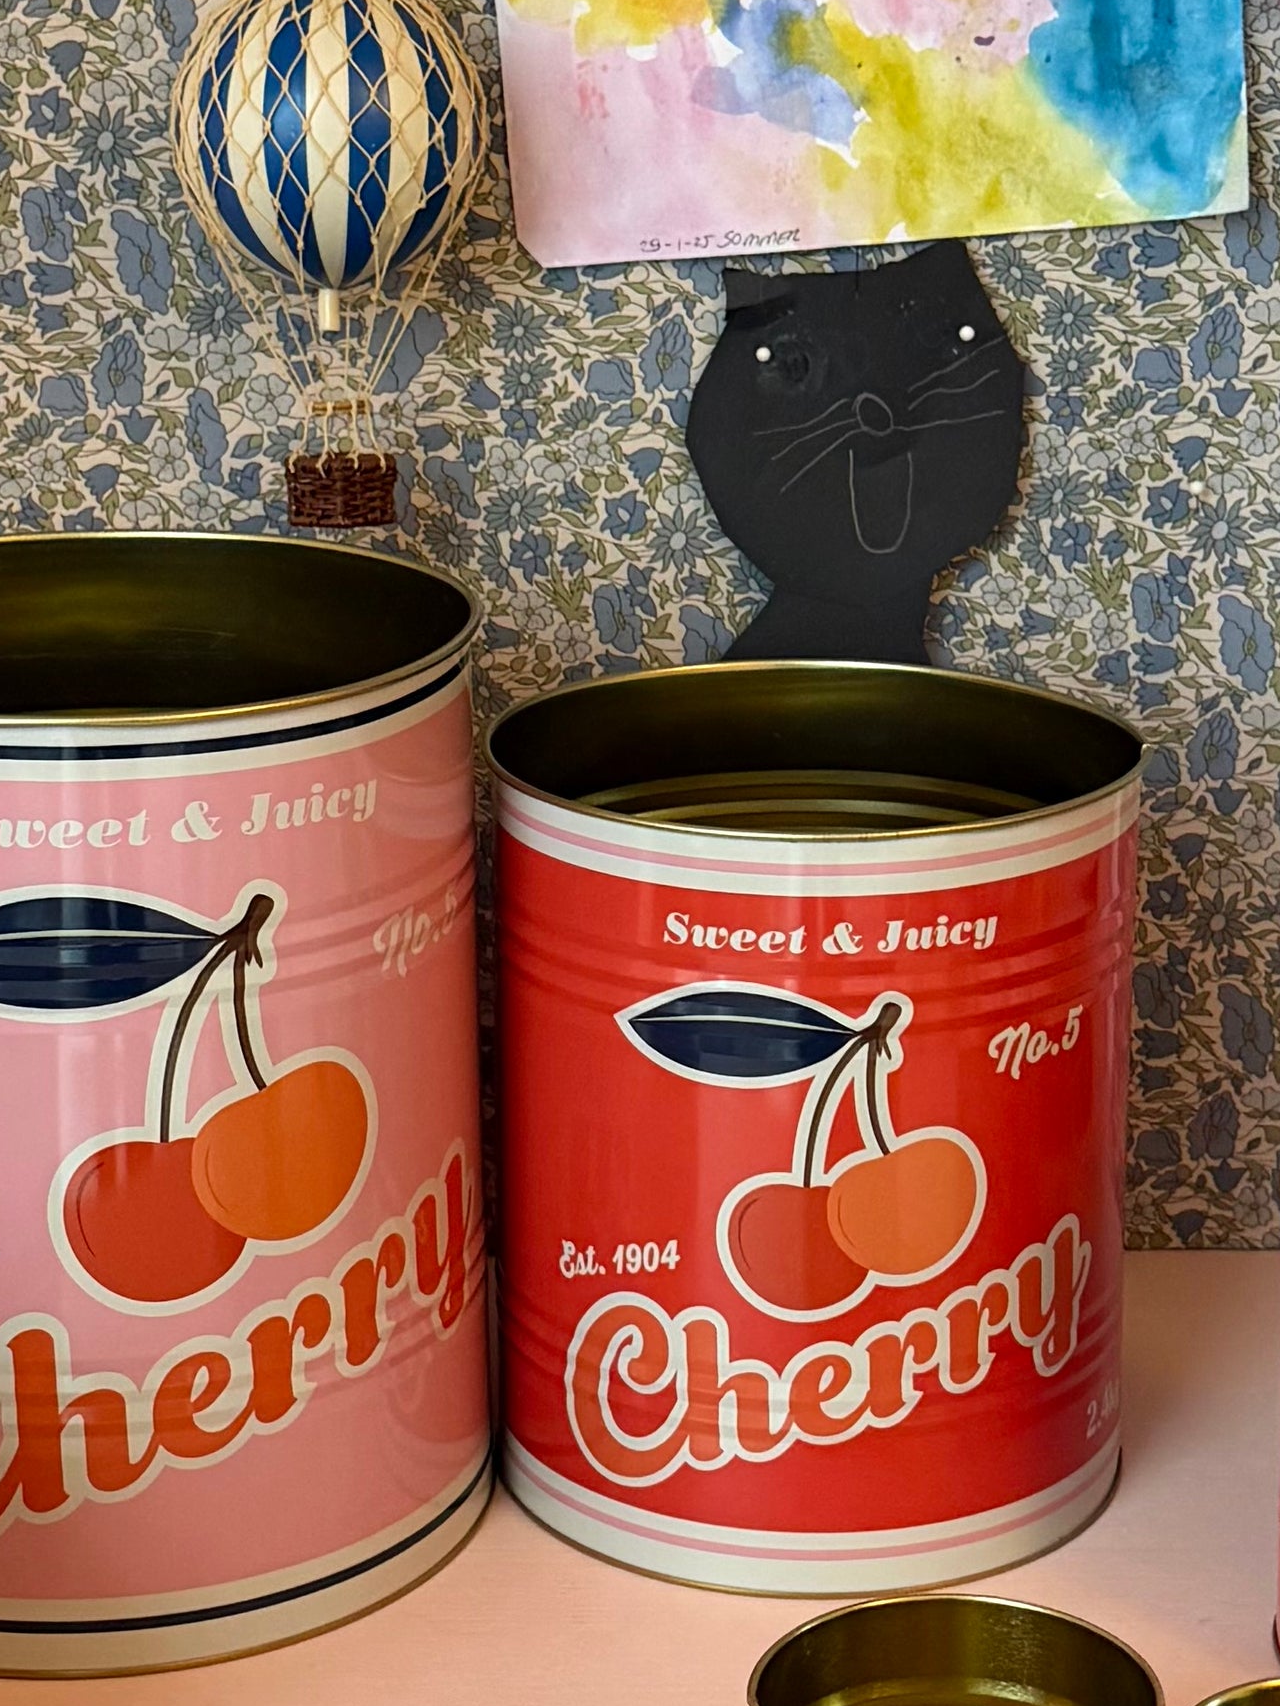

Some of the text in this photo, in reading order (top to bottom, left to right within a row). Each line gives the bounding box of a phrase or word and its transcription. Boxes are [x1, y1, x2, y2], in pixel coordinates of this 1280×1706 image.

[170, 800, 223, 845] &
[241, 778, 378, 836] Juicy
[663, 912, 998, 956] Sweet & Juicy
[988, 1005, 1083, 1080] No.5
[559, 1239, 681, 1279] Est. 1904
[566, 1214, 1091, 1486] Cherry
